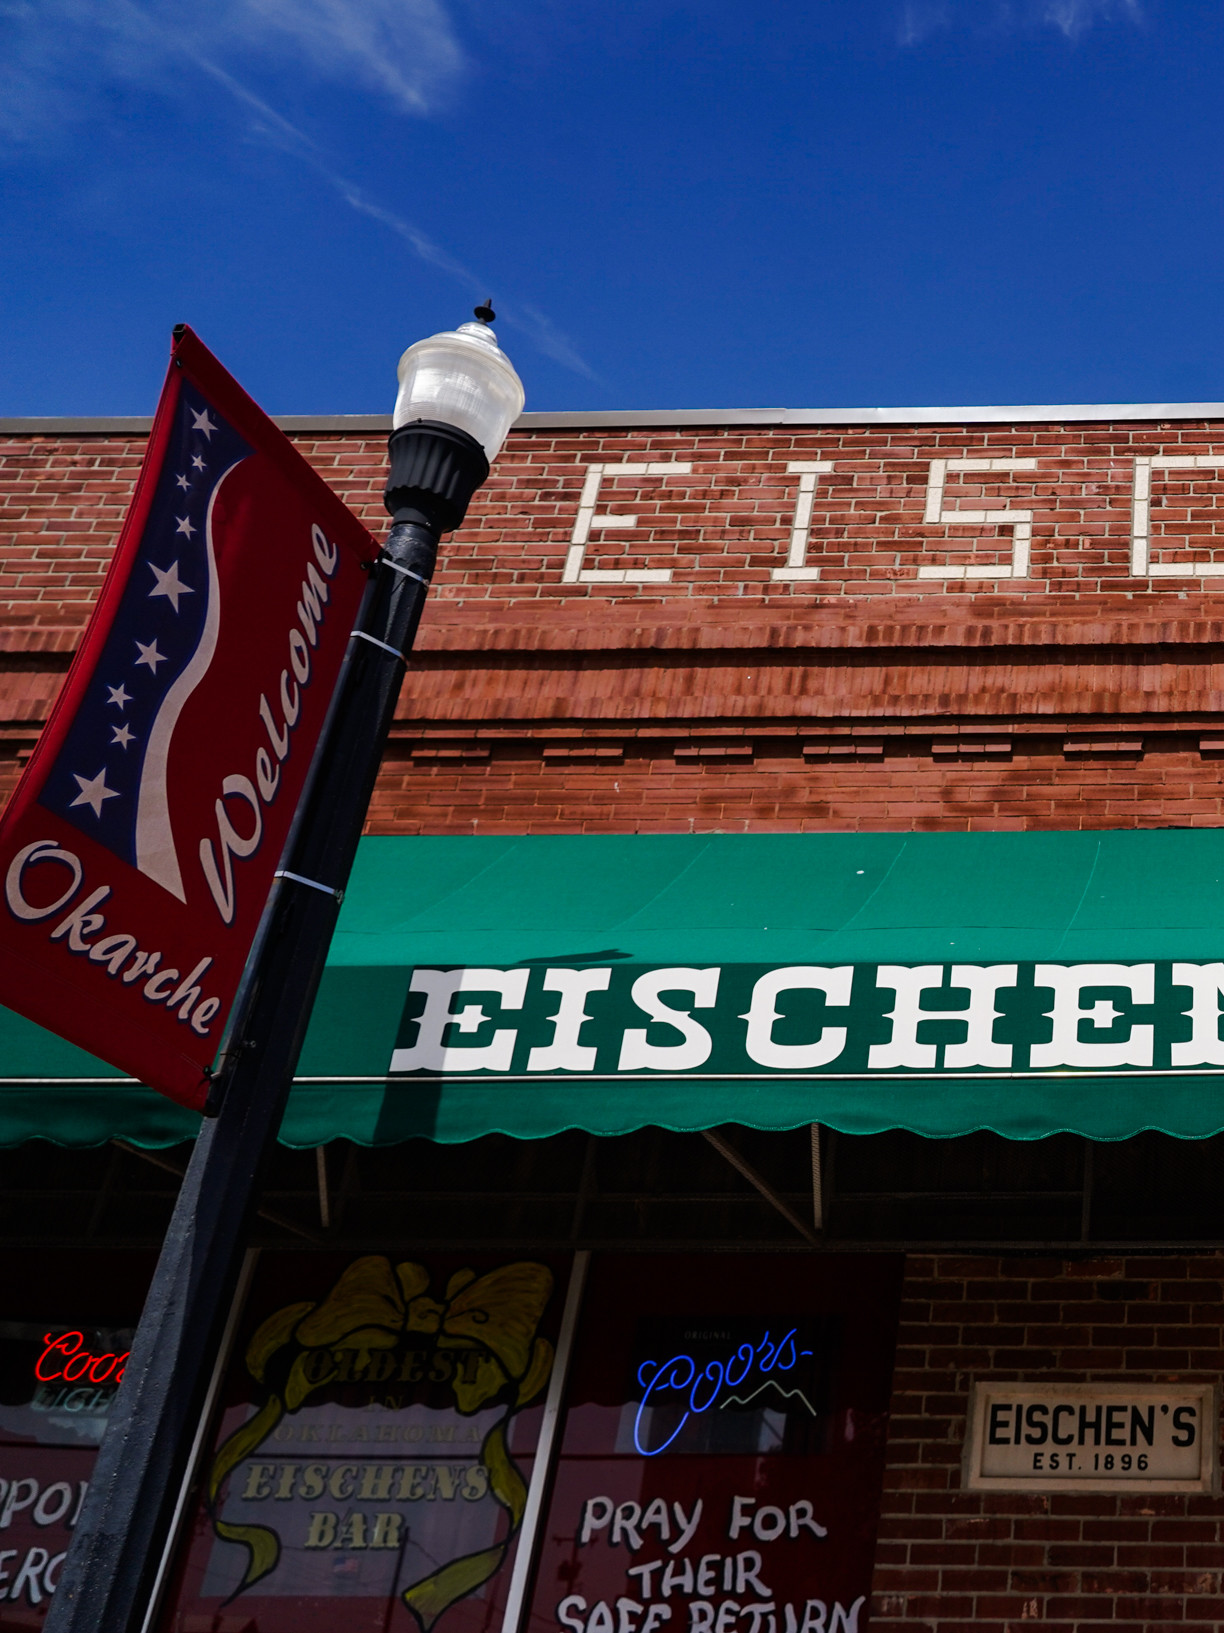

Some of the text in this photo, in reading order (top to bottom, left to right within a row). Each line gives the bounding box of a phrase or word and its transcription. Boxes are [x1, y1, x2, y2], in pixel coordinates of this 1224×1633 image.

[200, 523, 339, 924] Welcome
[6, 839, 220, 1034] Okarche
[304, 1348, 487, 1384] OLDEST
[272, 1424, 482, 1443] OKLAHOMA
[989, 1404, 1196, 1446] EISCHEN'S
[241, 1463, 491, 1500] EISCHENS
[1033, 1453, 1148, 1470] EST. 1896
[304, 1511, 405, 1549] BAR
[580, 1495, 828, 1554] PRAY FOR
[627, 1550, 773, 1598] THEIR
